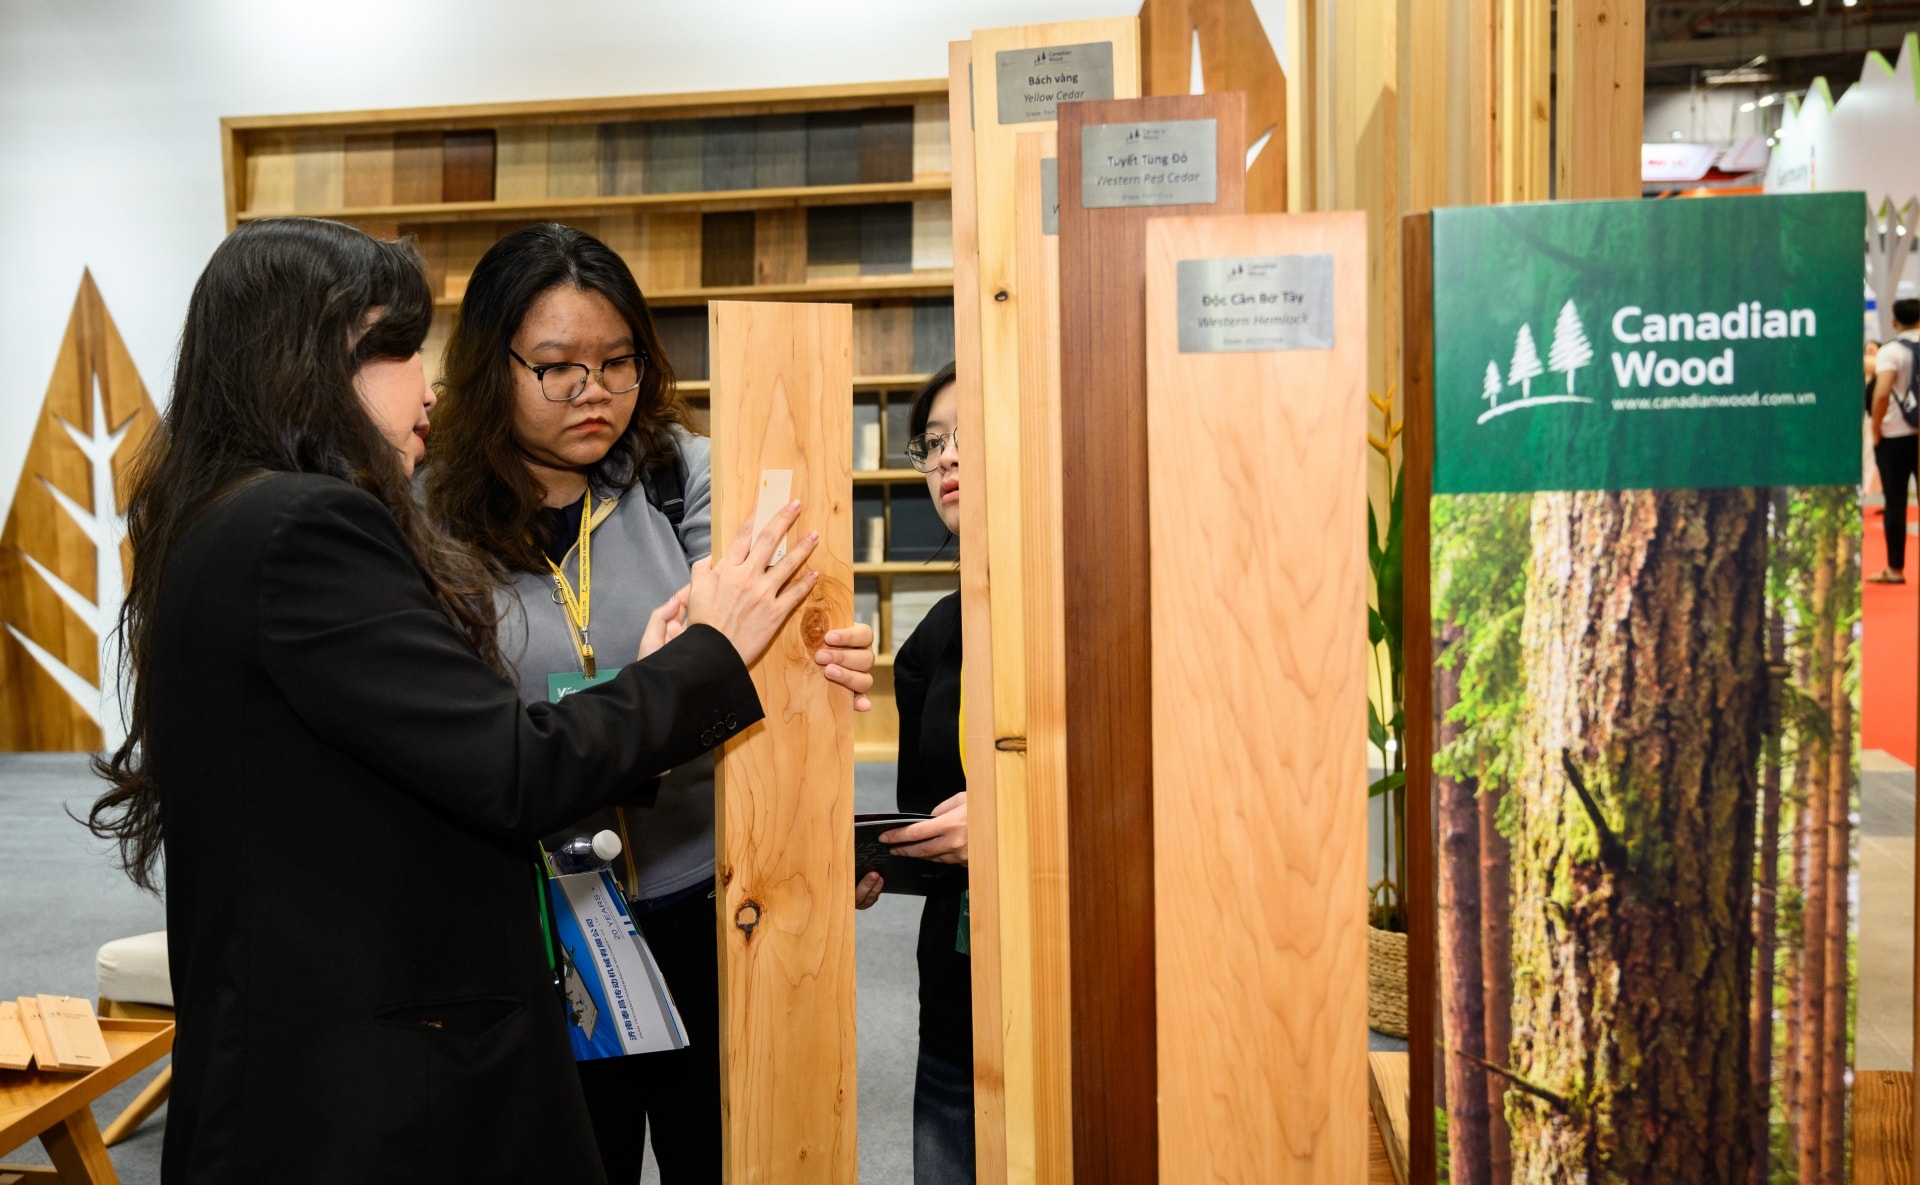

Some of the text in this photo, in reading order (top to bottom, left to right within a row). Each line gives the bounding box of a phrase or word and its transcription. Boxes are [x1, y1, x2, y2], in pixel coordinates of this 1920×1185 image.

[1028, 73, 1079, 86] Bách vàng
[1023, 90, 1085, 104] Yellow Cedar
[1096, 171, 1200, 187] Western Red Cedar
[1197, 313, 1308, 329] Western Hemlock
[1611, 301, 1817, 344] Canadian
[1611, 348, 1734, 388] Wood
[1611, 391, 1817, 411] www.canadianwood.com.vn
[593, 894, 613, 927] YEARS
[611, 929, 621, 940] 20
